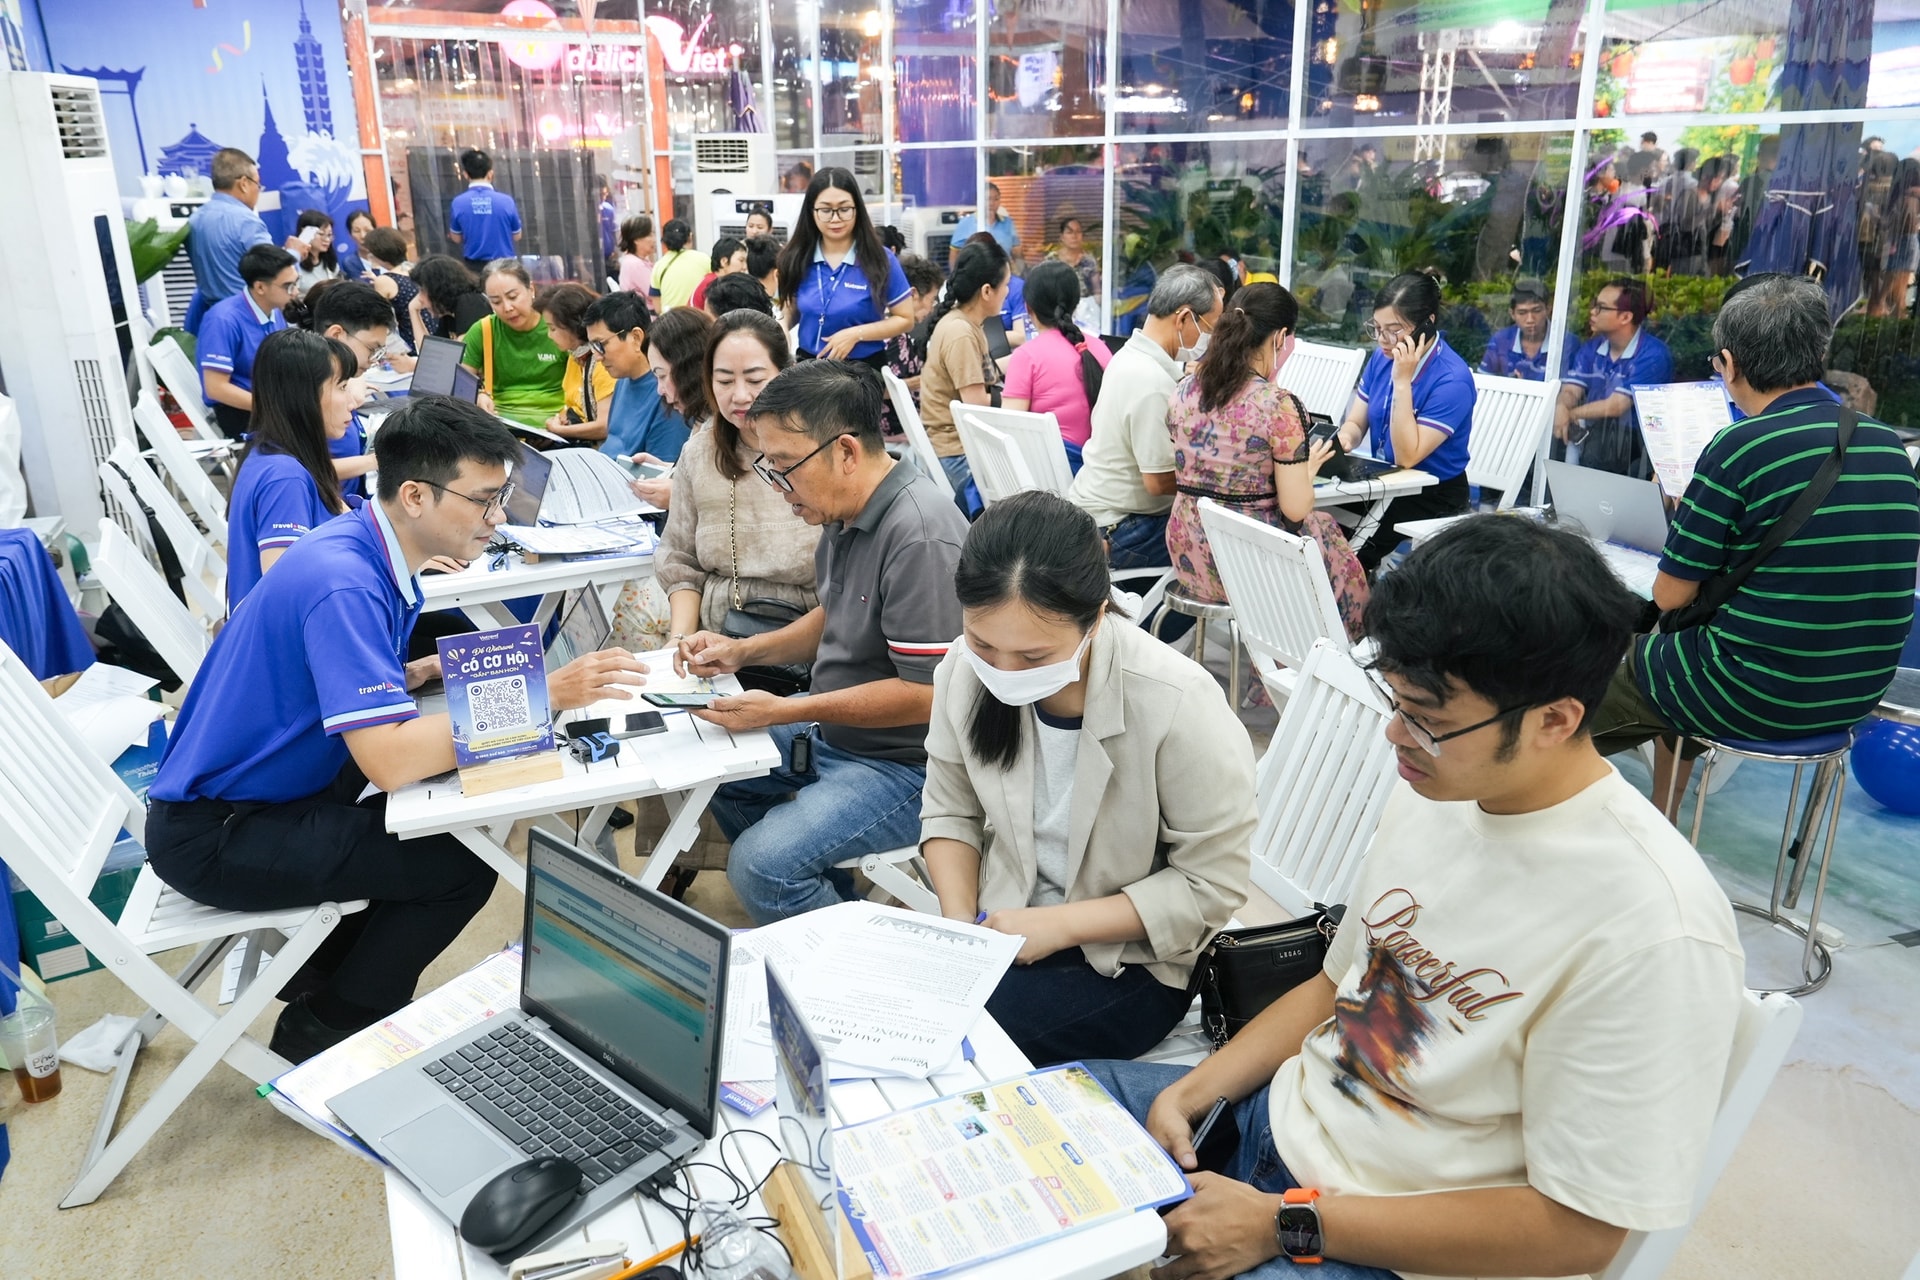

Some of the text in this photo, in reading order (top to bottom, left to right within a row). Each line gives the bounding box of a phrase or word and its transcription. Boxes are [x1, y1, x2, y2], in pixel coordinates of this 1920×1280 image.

[460, 651, 529, 674] CÓ CƠ HỘI
[358, 682, 386, 695] travel
[1361, 887, 1525, 1022] Powerful
[602, 1051, 616, 1066] DELL
